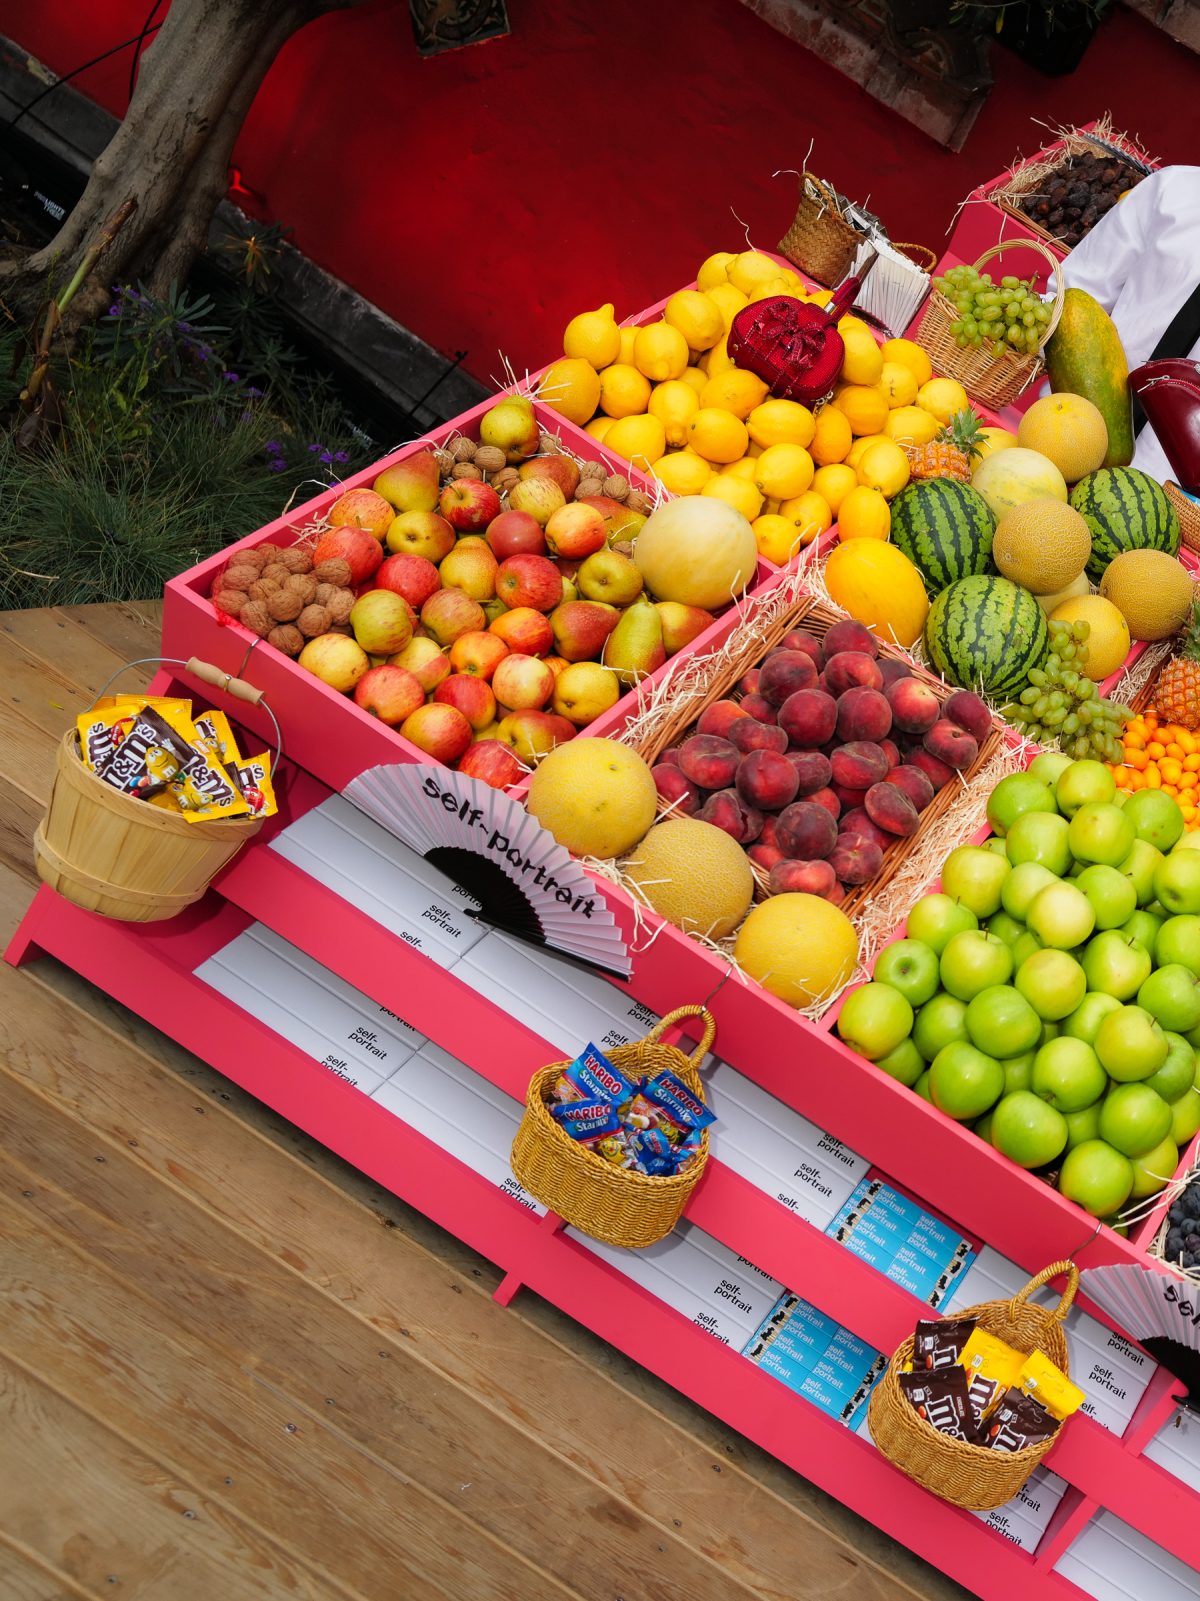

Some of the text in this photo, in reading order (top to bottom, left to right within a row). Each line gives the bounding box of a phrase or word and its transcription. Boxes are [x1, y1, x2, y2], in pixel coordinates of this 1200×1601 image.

[422, 777, 596, 919] self-portrait
[452, 884, 483, 908] portra
[429, 904, 452, 921] self-
[421, 910, 462, 939] portrait
[400, 931, 423, 948] self-
[627, 1008, 657, 1030] portr
[356, 1026, 379, 1043] self-
[608, 1030, 629, 1045] self-
[347, 1032, 388, 1060] portrait
[326, 1055, 349, 1072] self-
[584, 1054, 623, 1096] HARIBO
[654, 1088, 693, 1123] Starmix
[660, 1079, 704, 1116] HARIBO
[816, 1139, 856, 1168] portrait
[800, 1162, 822, 1179] self-
[793, 1169, 833, 1198] portrait
[777, 1193, 799, 1211] self-
[875, 1193, 906, 1215] portrait
[881, 1188, 897, 1202] self-
[866, 1209, 898, 1232] portrait
[872, 1204, 888, 1218] self-
[860, 1218, 876, 1232] self-
[915, 1220, 946, 1243] portrait
[920, 1215, 937, 1229] self-
[850, 1234, 867, 1248] self-
[856, 1224, 886, 1247] portrait
[912, 1231, 928, 1244] self-
[845, 1240, 876, 1263] portrait
[900, 1247, 917, 1260] self-
[907, 1236, 938, 1260] portrait
[891, 1263, 908, 1277] self-
[896, 1253, 926, 1276] portrait
[720, 1279, 742, 1296] self-
[887, 1268, 918, 1292] portrait
[714, 1286, 753, 1314] portrait
[799, 1302, 816, 1315] self-
[697, 1312, 719, 1329] self-
[789, 1318, 806, 1331] self-
[794, 1307, 824, 1329] portrait
[778, 1334, 795, 1347] self-
[784, 1323, 815, 1346] portrait
[834, 1334, 864, 1356] portrait
[839, 1328, 855, 1342] self-
[766, 1351, 782, 1364] self-
[773, 1339, 804, 1362] portrait
[829, 1345, 846, 1358] self-
[1107, 1338, 1145, 1366] portrait
[762, 1356, 792, 1379] portrait
[818, 1361, 835, 1375] self-
[823, 1350, 855, 1373] portrait
[813, 1366, 844, 1390] portrait
[1093, 1364, 1115, 1381] self-
[800, 1383, 832, 1406] portrait
[805, 1377, 823, 1391] self-
[1088, 1371, 1127, 1400] portrait
[1081, 1402, 1097, 1416] elf-
[1016, 1491, 1041, 1512] rtrait
[989, 1511, 1011, 1528] self-
